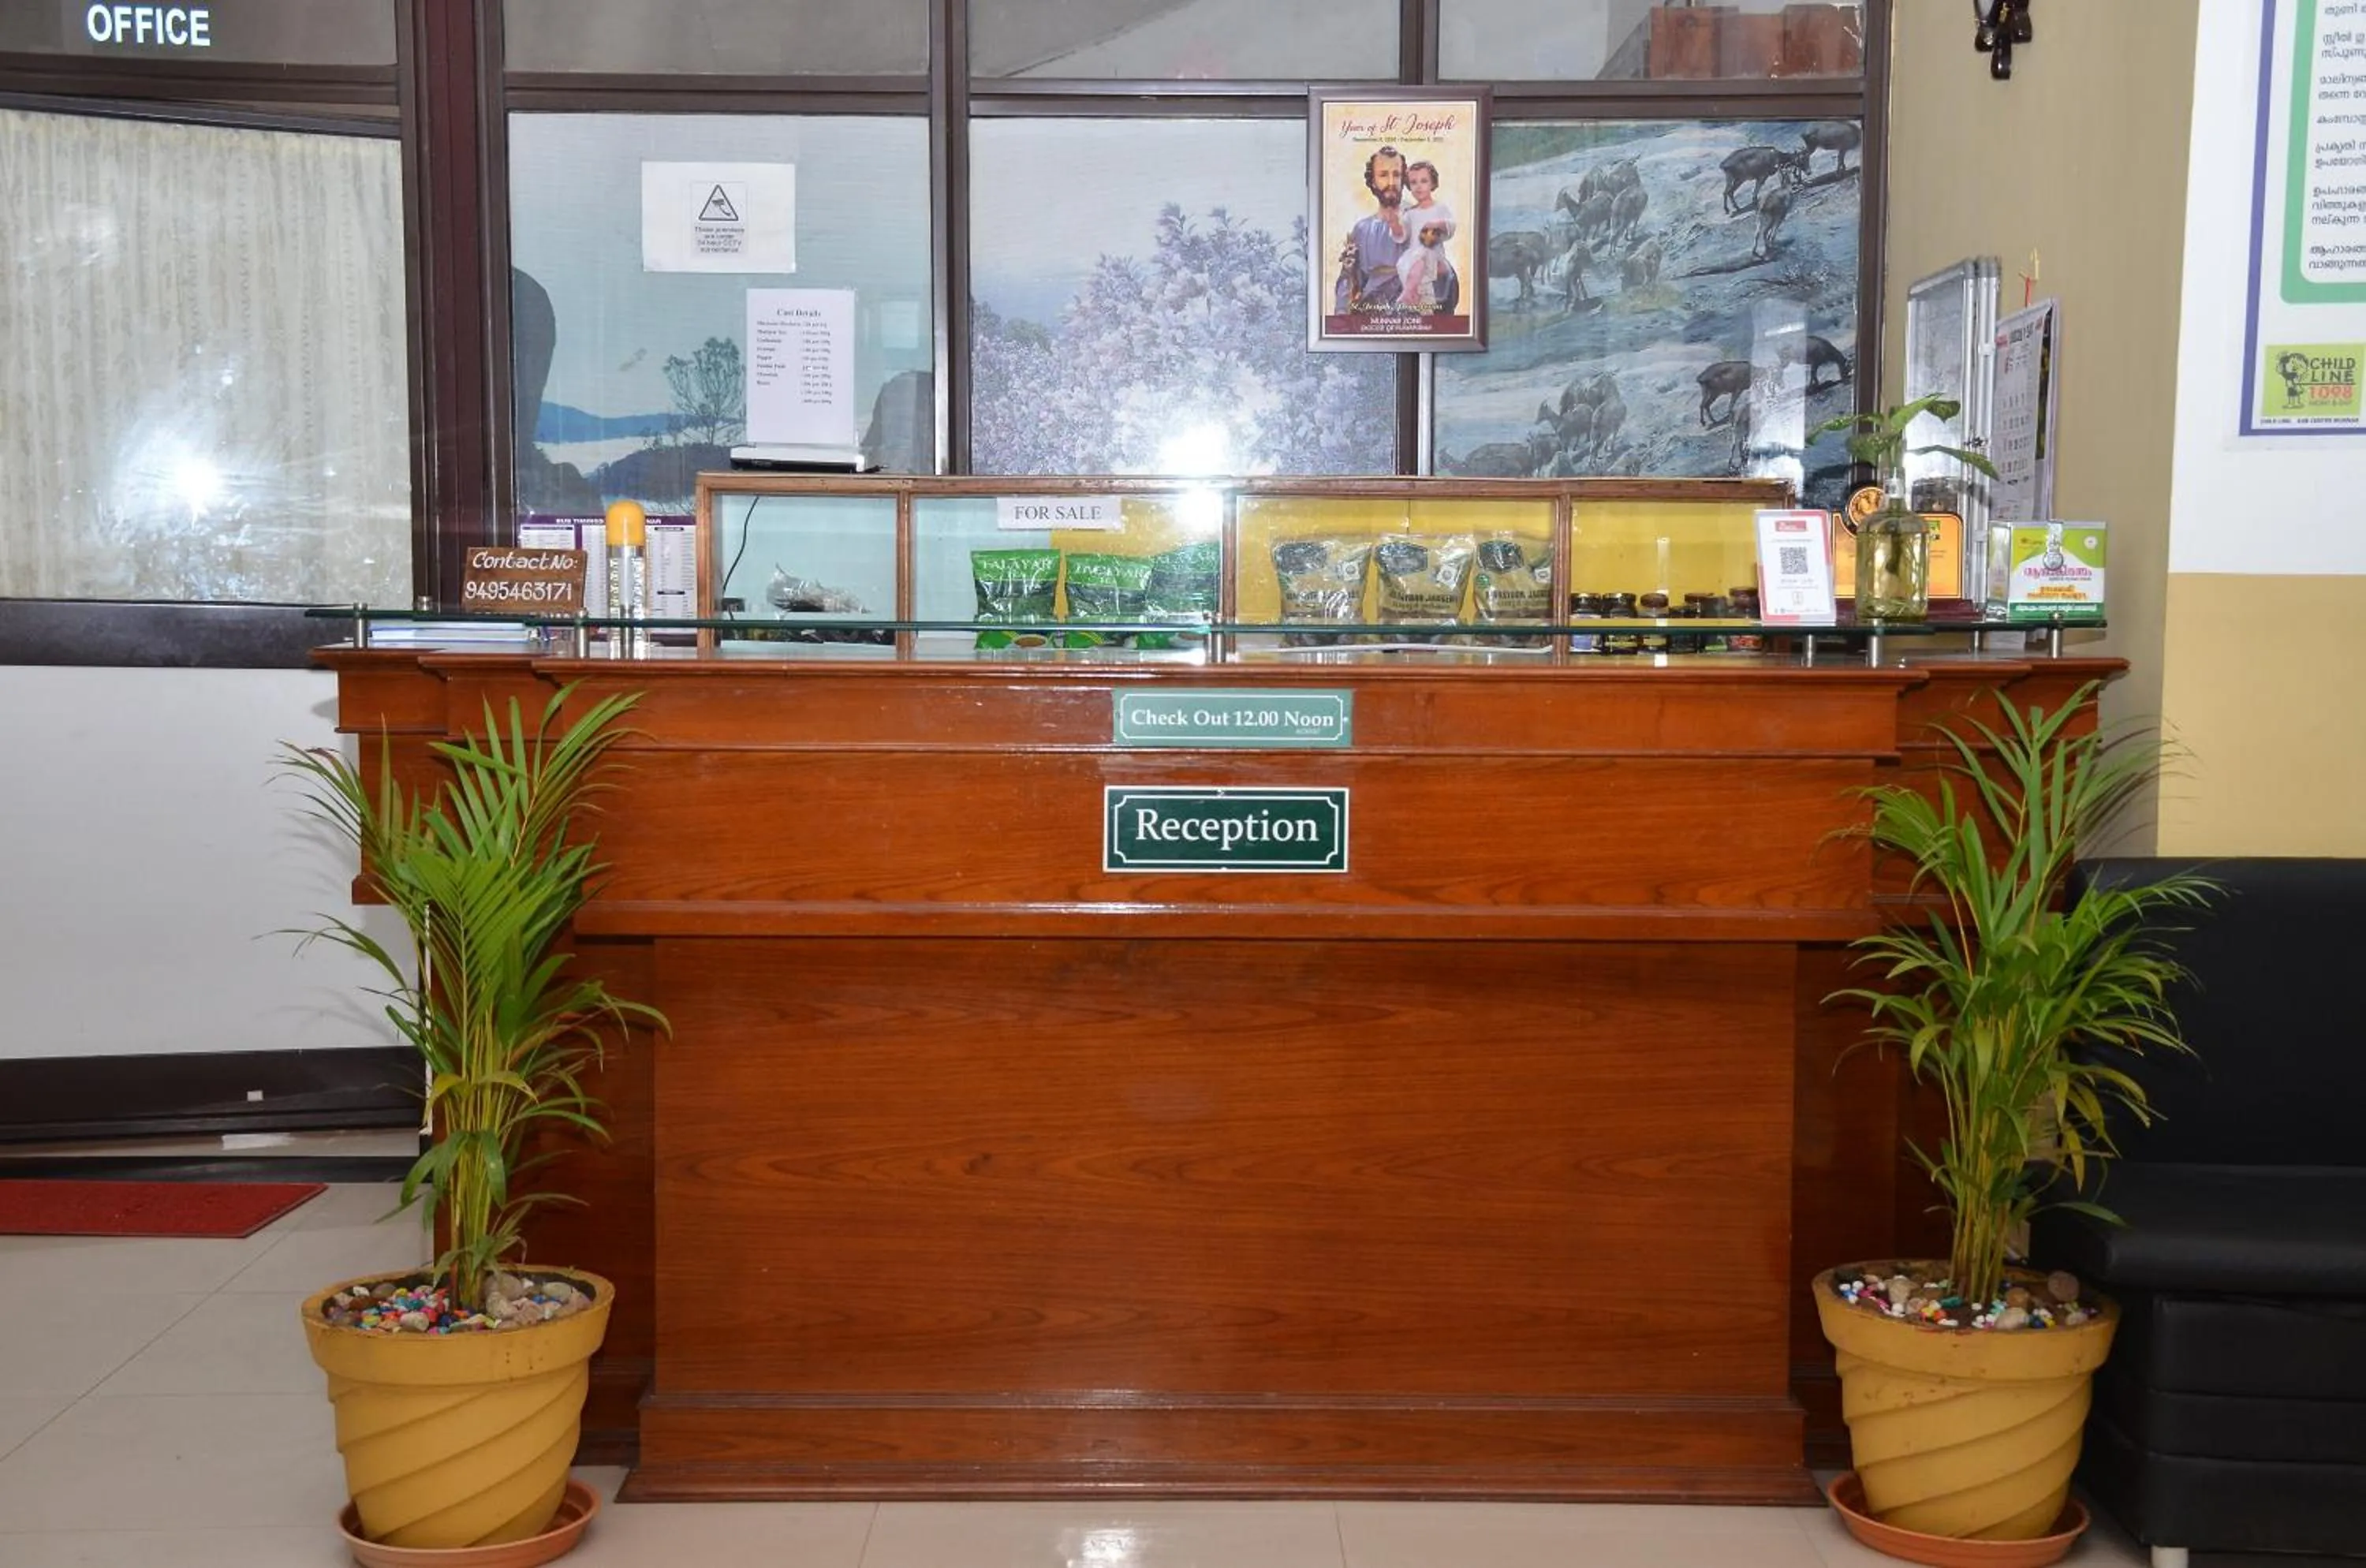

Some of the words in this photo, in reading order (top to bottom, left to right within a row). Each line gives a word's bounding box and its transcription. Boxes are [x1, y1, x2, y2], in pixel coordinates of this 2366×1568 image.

[87, 4, 211, 47] OFFICE
[1380, 114, 1401, 133] St
[1402, 113, 1456, 135] Joseph
[2310, 357, 2357, 370] CHILD
[2311, 370, 2354, 383] LINE
[2310, 386, 2353, 400] 1098
[1014, 506, 1051, 521] FOR
[1054, 506, 1103, 521] SALE
[472, 550, 550, 570] Contact
[550, 554, 579, 570] No:
[465, 581, 573, 602] 9495463171
[1131, 709, 1189, 726] Check
[1193, 710, 1230, 727] Out
[1234, 711, 1279, 727] 12.00
[1283, 711, 1334, 727] Noon
[1135, 808, 1320, 851] Reception
